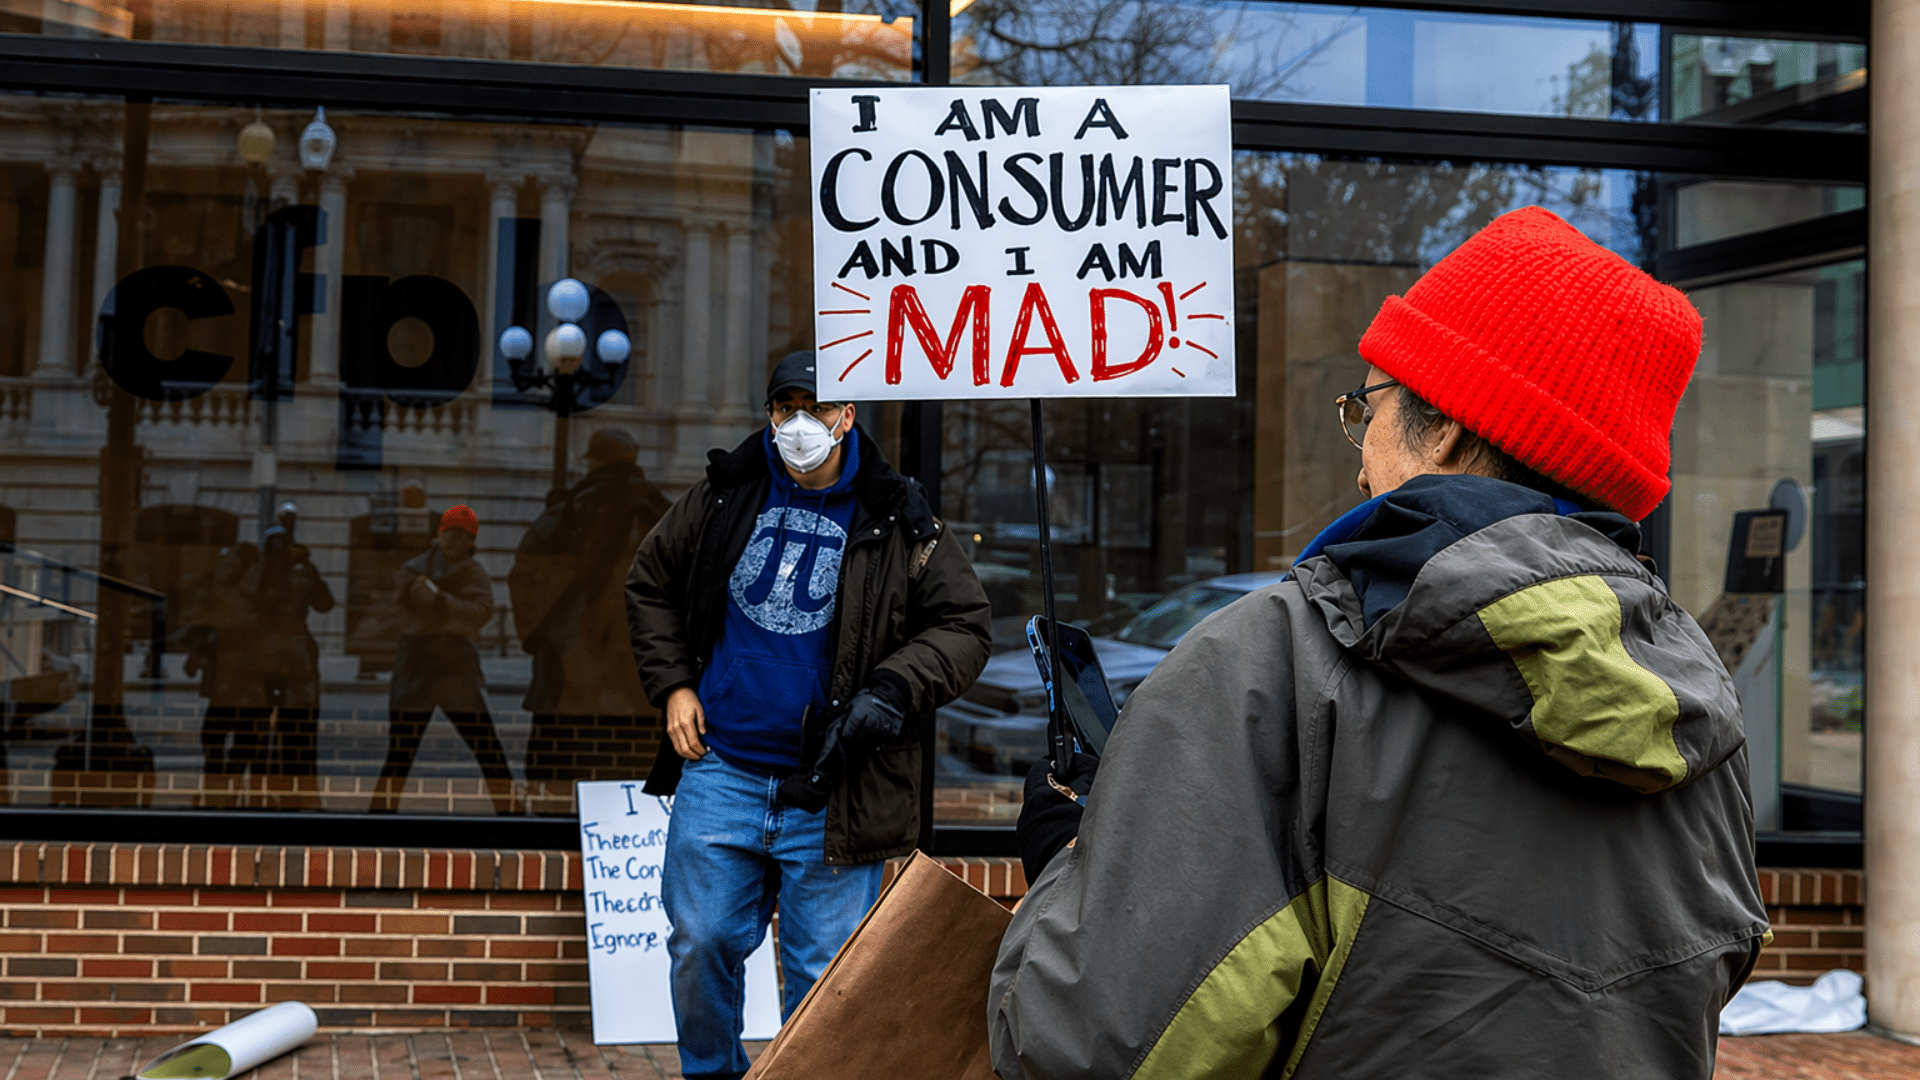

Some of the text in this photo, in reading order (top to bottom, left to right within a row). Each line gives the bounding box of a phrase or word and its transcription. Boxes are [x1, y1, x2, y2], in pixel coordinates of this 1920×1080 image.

[852, 95, 1129, 141] I AM A
[819, 147, 1229, 240] CONSUMER
[837, 235, 1163, 282] AND I AM
[96, 204, 631, 471] cfpb
[885, 281, 1181, 387] MAD!
[620, 784, 639, 816] I
[586, 855, 621, 879] The
